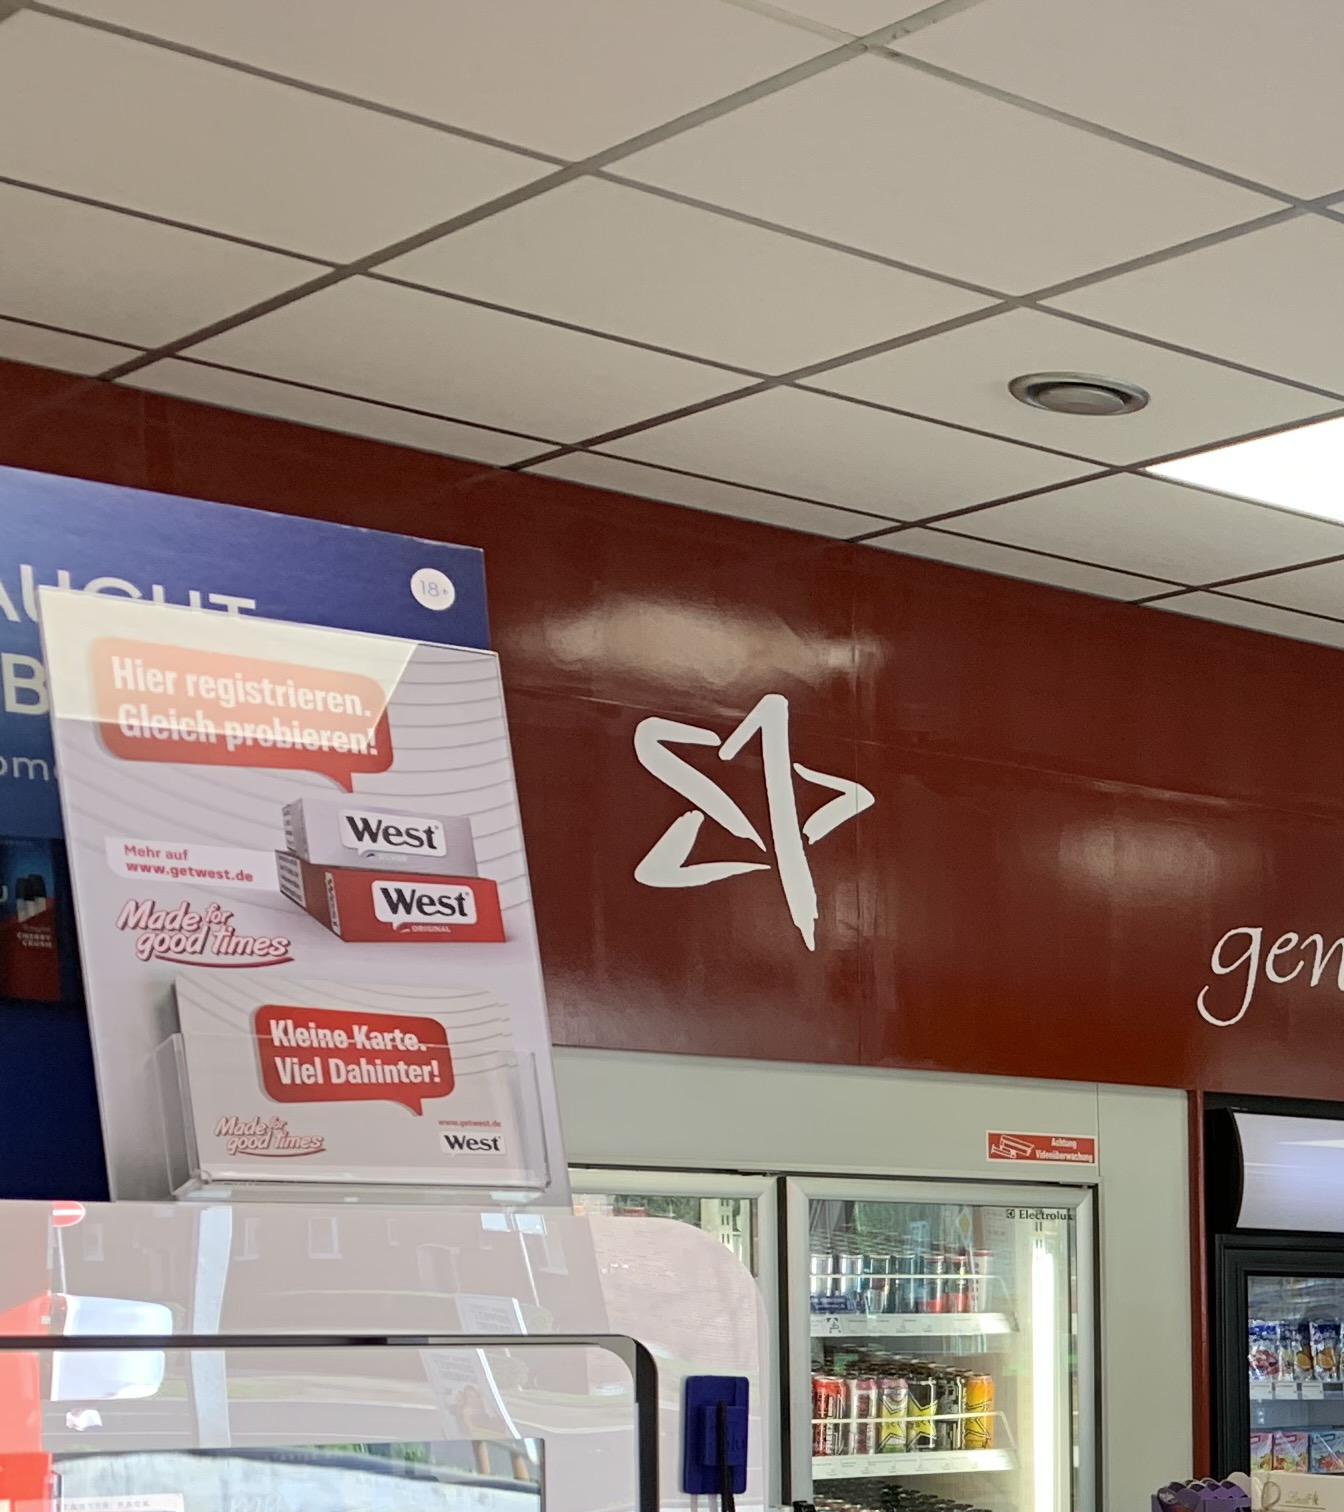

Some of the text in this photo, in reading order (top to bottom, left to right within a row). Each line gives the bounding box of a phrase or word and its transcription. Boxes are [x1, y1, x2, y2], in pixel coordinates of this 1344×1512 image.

[419, 578, 449, 598] 18+
[112, 655, 372, 719] Hier registrieren.
[118, 703, 378, 757] Gleich probieren!
[345, 816, 436, 850] West
[124, 844, 188, 861] Mehr auf
[126, 862, 253, 882] www.getwest.de
[381, 887, 468, 917] West
[116, 900, 234, 932] Made for
[412, 925, 451, 933] ORIGINAL
[135, 928, 291, 961] good times
[269, 1019, 427, 1051] Kleine Karte.
[274, 1057, 440, 1084] Viel Dahinter!
[214, 1116, 287, 1136] Made for
[438, 1119, 502, 1127] www.getwest.de
[226, 1131, 324, 1155] good times
[1050, 1137, 1077, 1150] Achtung
[1035, 1148, 1094, 1163] Videoüberwachung
[1018, 1209, 1073, 1221] Electrolux
